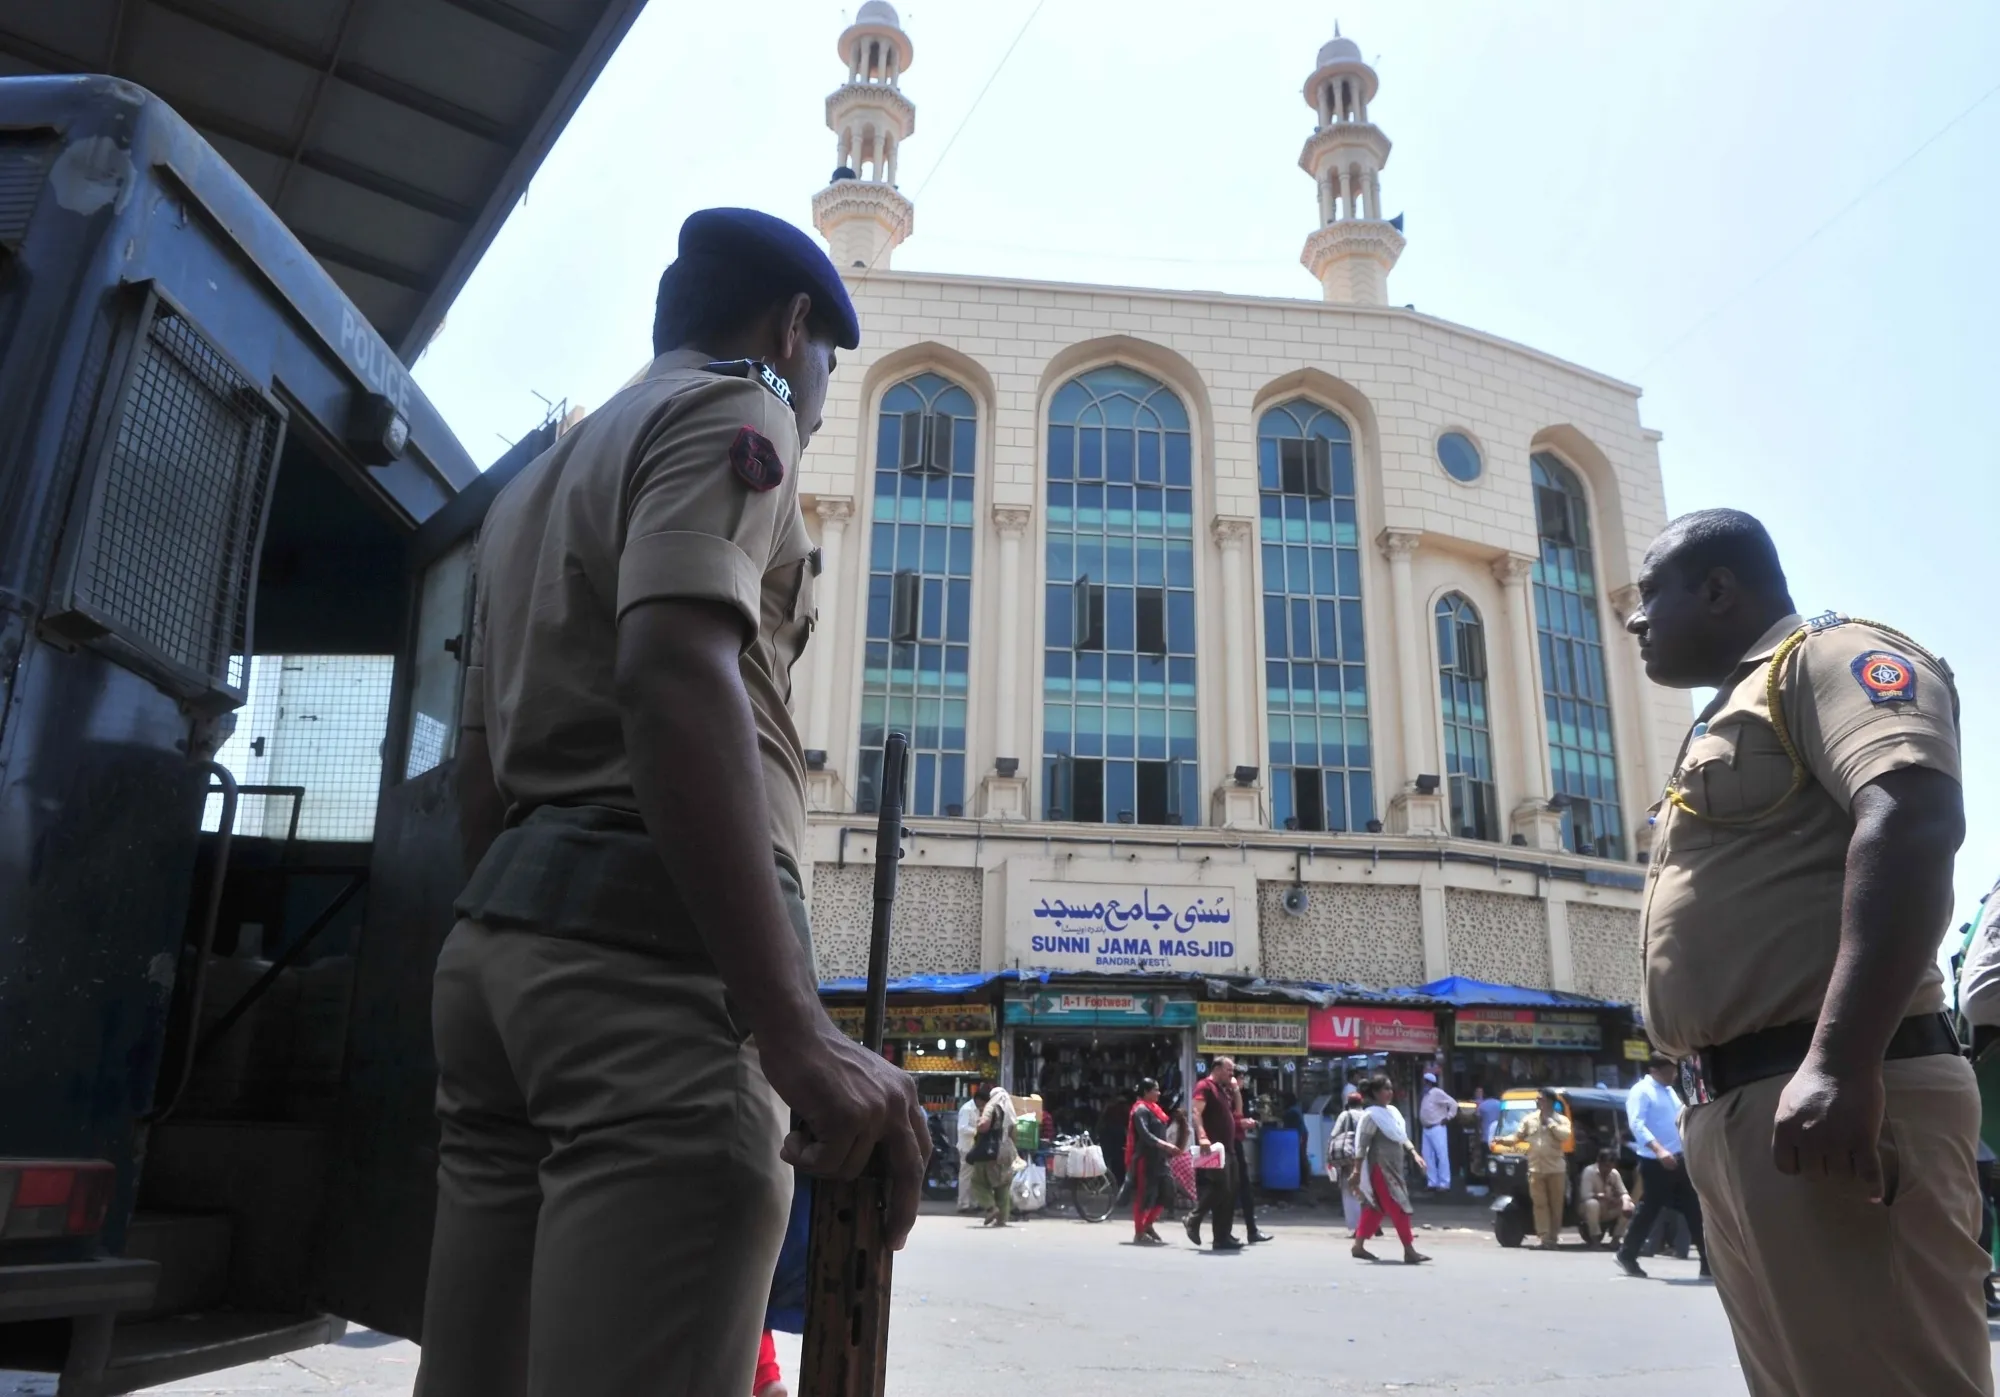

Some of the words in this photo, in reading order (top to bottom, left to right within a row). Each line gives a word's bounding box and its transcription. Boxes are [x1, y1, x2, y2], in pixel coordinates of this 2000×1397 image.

[341, 306, 411, 420] POLICE
[1033, 898, 1105, 927] مسجد
[1104, 887, 1173, 932] جامع
[1031, 935, 1090, 954] SUNNI
[1097, 938, 1152, 956] JAMA
[1159, 939, 1234, 958] MASJID
[1095, 957, 1136, 967] BANDRA
[1063, 996, 1080, 1007] A-1
[1085, 996, 1131, 1008] Footwear
[1205, 1024, 1226, 1038] JUMBO
[1228, 1025, 1246, 1039] GLASS
